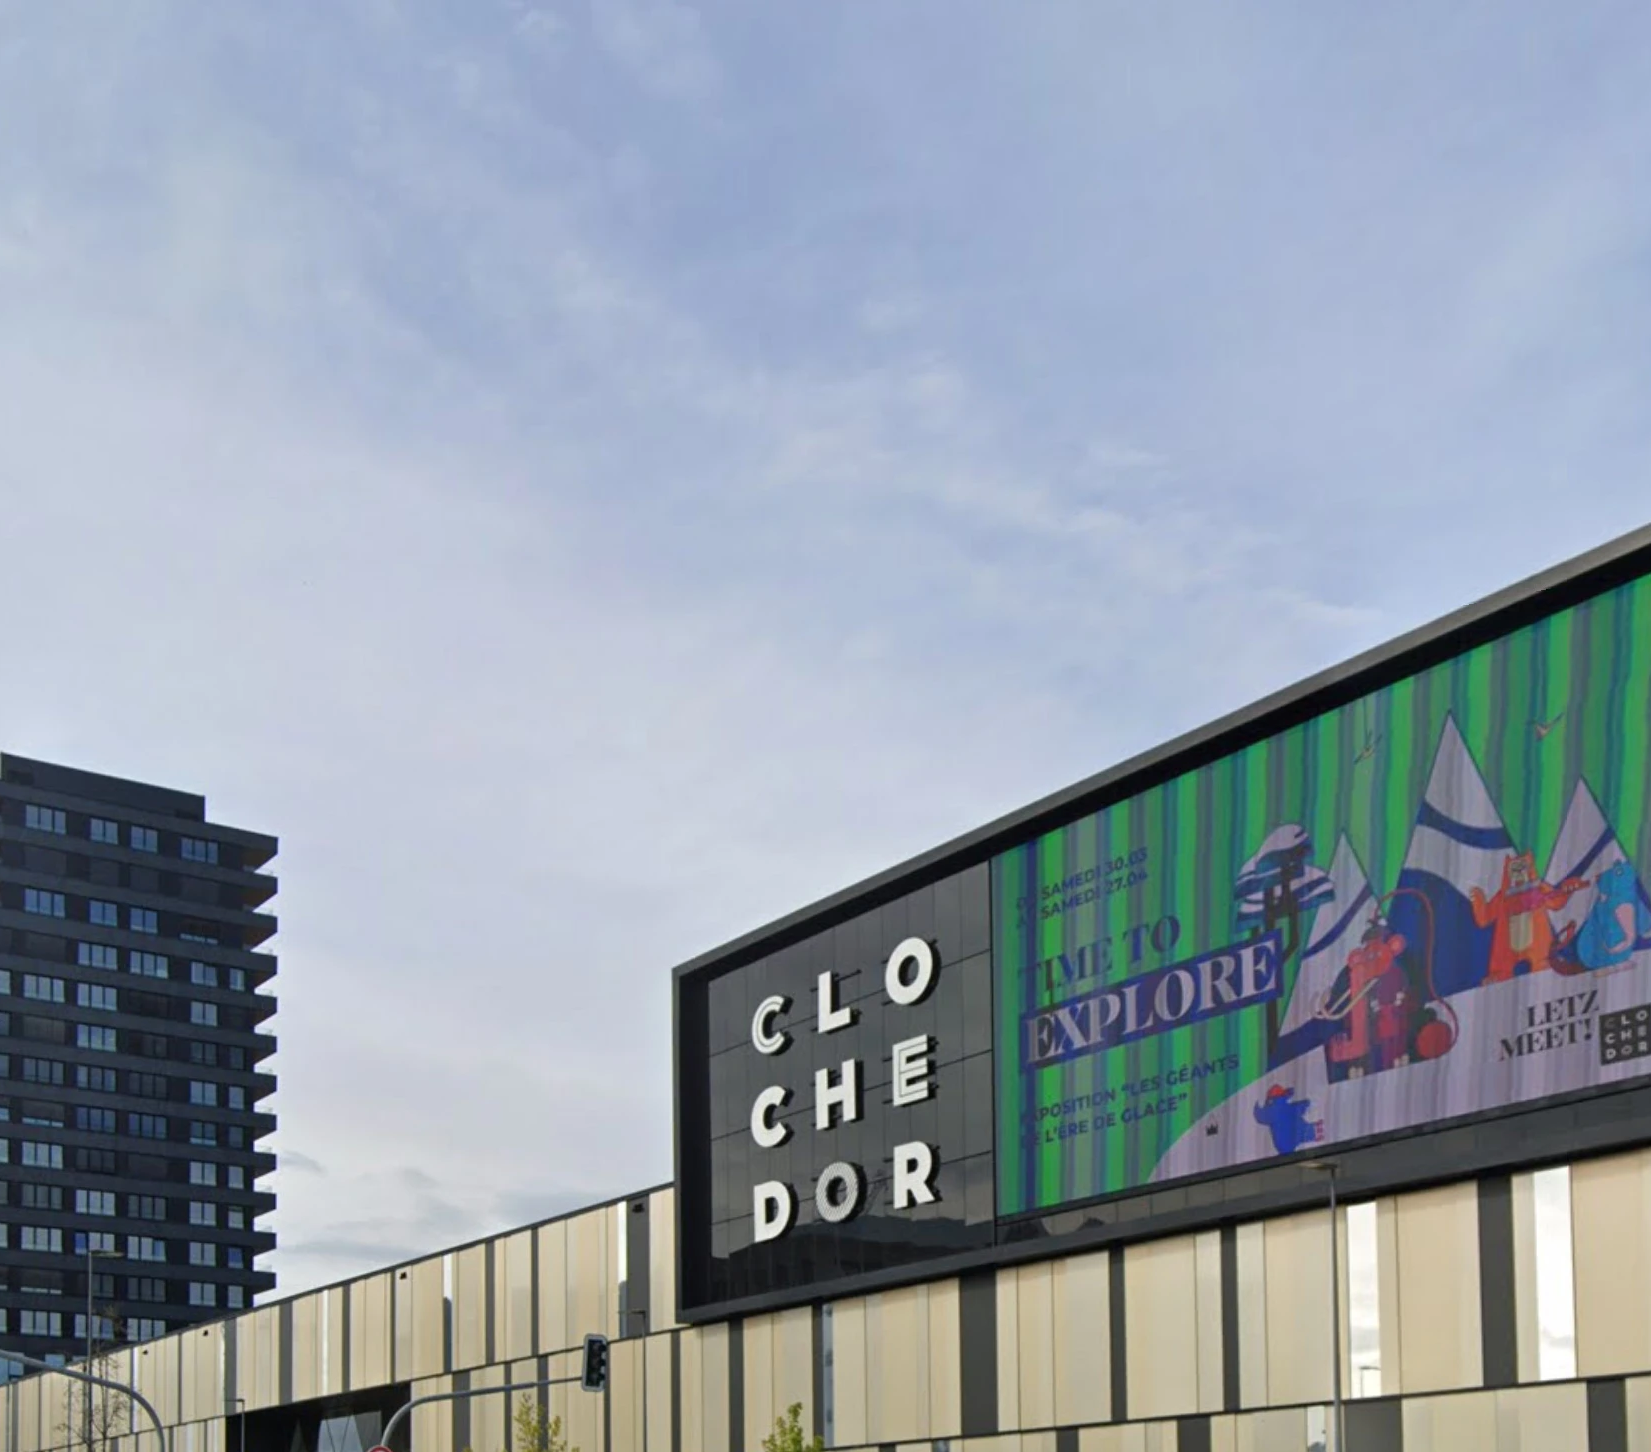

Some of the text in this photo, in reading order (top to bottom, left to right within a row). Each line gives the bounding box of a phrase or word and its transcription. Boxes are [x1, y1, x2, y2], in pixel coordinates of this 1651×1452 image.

[1041, 865, 1101, 900] SAMEDI
[1041, 886, 1101, 920] SAMEDI
[1123, 914, 1181, 965] TO
[1028, 939, 1277, 1064] EXPLORE
[1527, 989, 1600, 1028] LETZ
[1499, 1018, 1592, 1062] MEET!
[1023, 1087, 1116, 1126] POSITION
[1165, 1053, 1240, 1087] GÉANTS
[1093, 1111, 1117, 1131] DE
